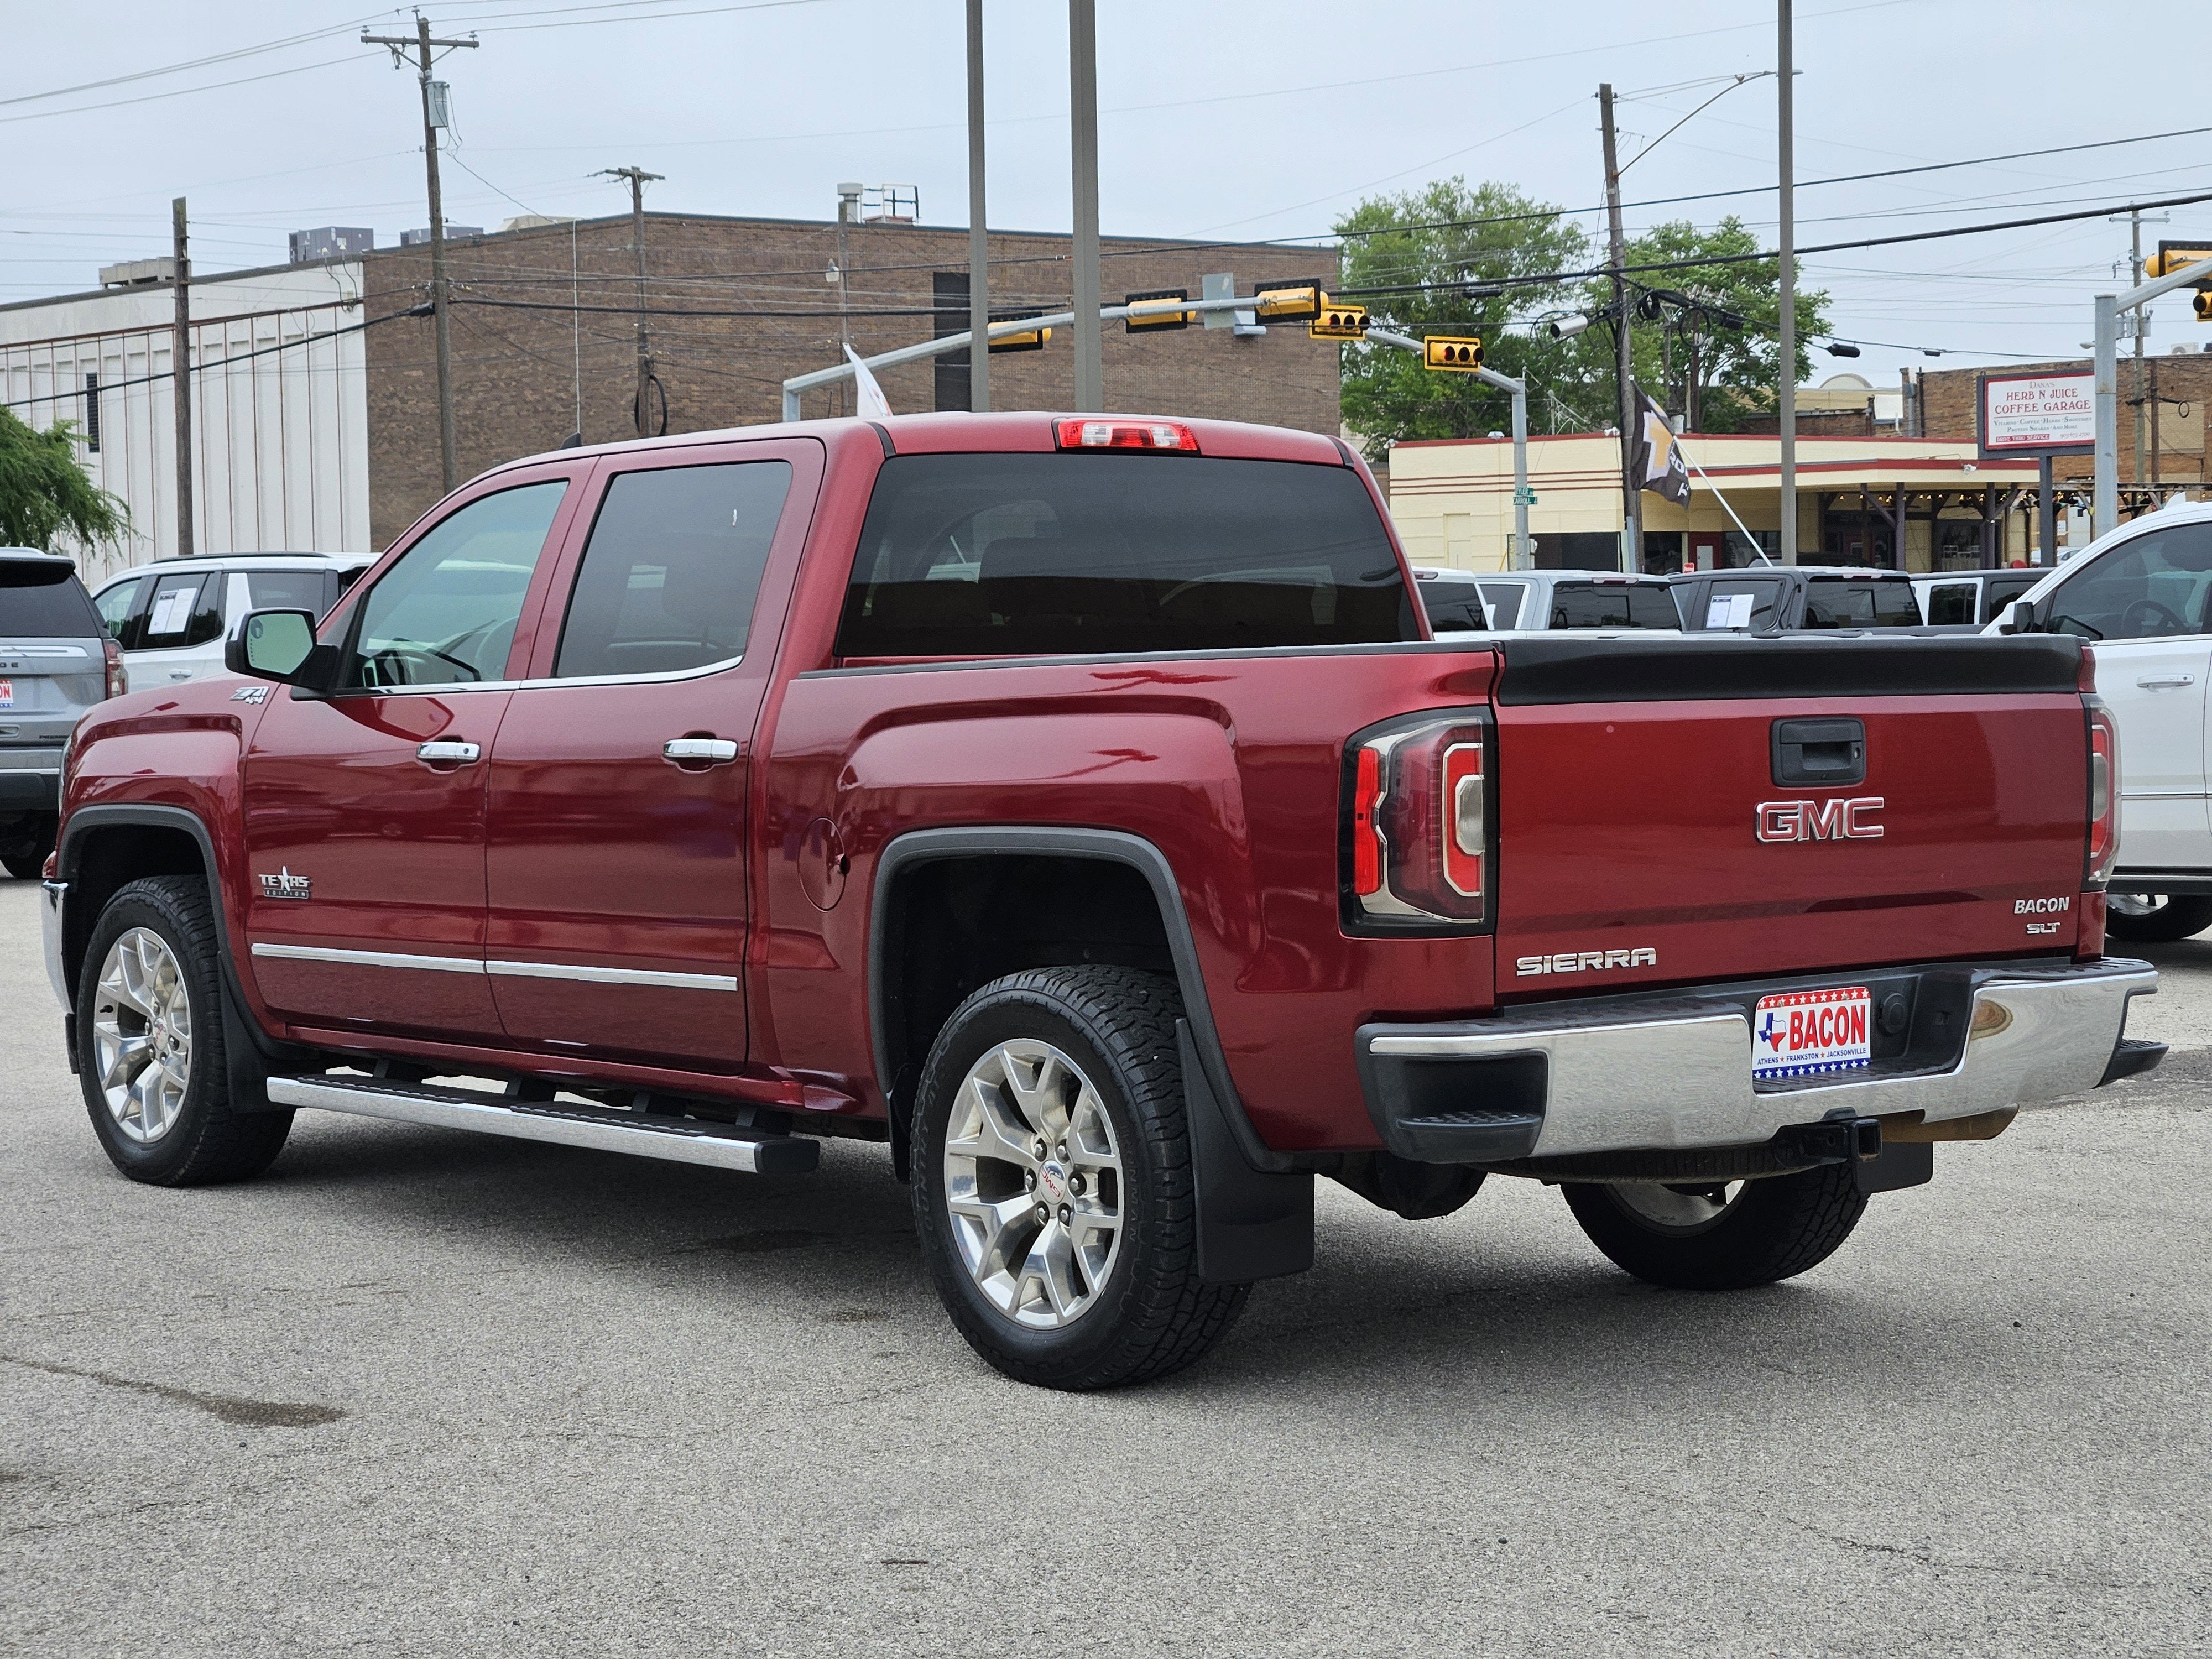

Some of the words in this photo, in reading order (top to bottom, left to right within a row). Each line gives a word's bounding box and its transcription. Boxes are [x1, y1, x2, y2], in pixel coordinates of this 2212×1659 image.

[2006, 390, 2034, 401] HERB
[2039, 390, 2046, 399] N
[2050, 388, 2078, 399] JUICE
[1995, 403, 2039, 414] COFFEE
[2043, 400, 2091, 411] GARAGE
[1756, 797, 1884, 842] GMC
[258, 866, 311, 891] TEXAS
[2014, 896, 2070, 914] BACON
[2027, 922, 2061, 935] SLT
[1516, 947, 1656, 977] SIERRA
[1790, 1004, 1866, 1051] BACON
[1757, 1056, 1779, 1065] ATHENS
[1786, 1052, 1819, 1062] FRANKSTON
[1827, 1048, 1866, 1057] JACKSONVILLE
[1040, 1166, 1061, 1198] GMC
